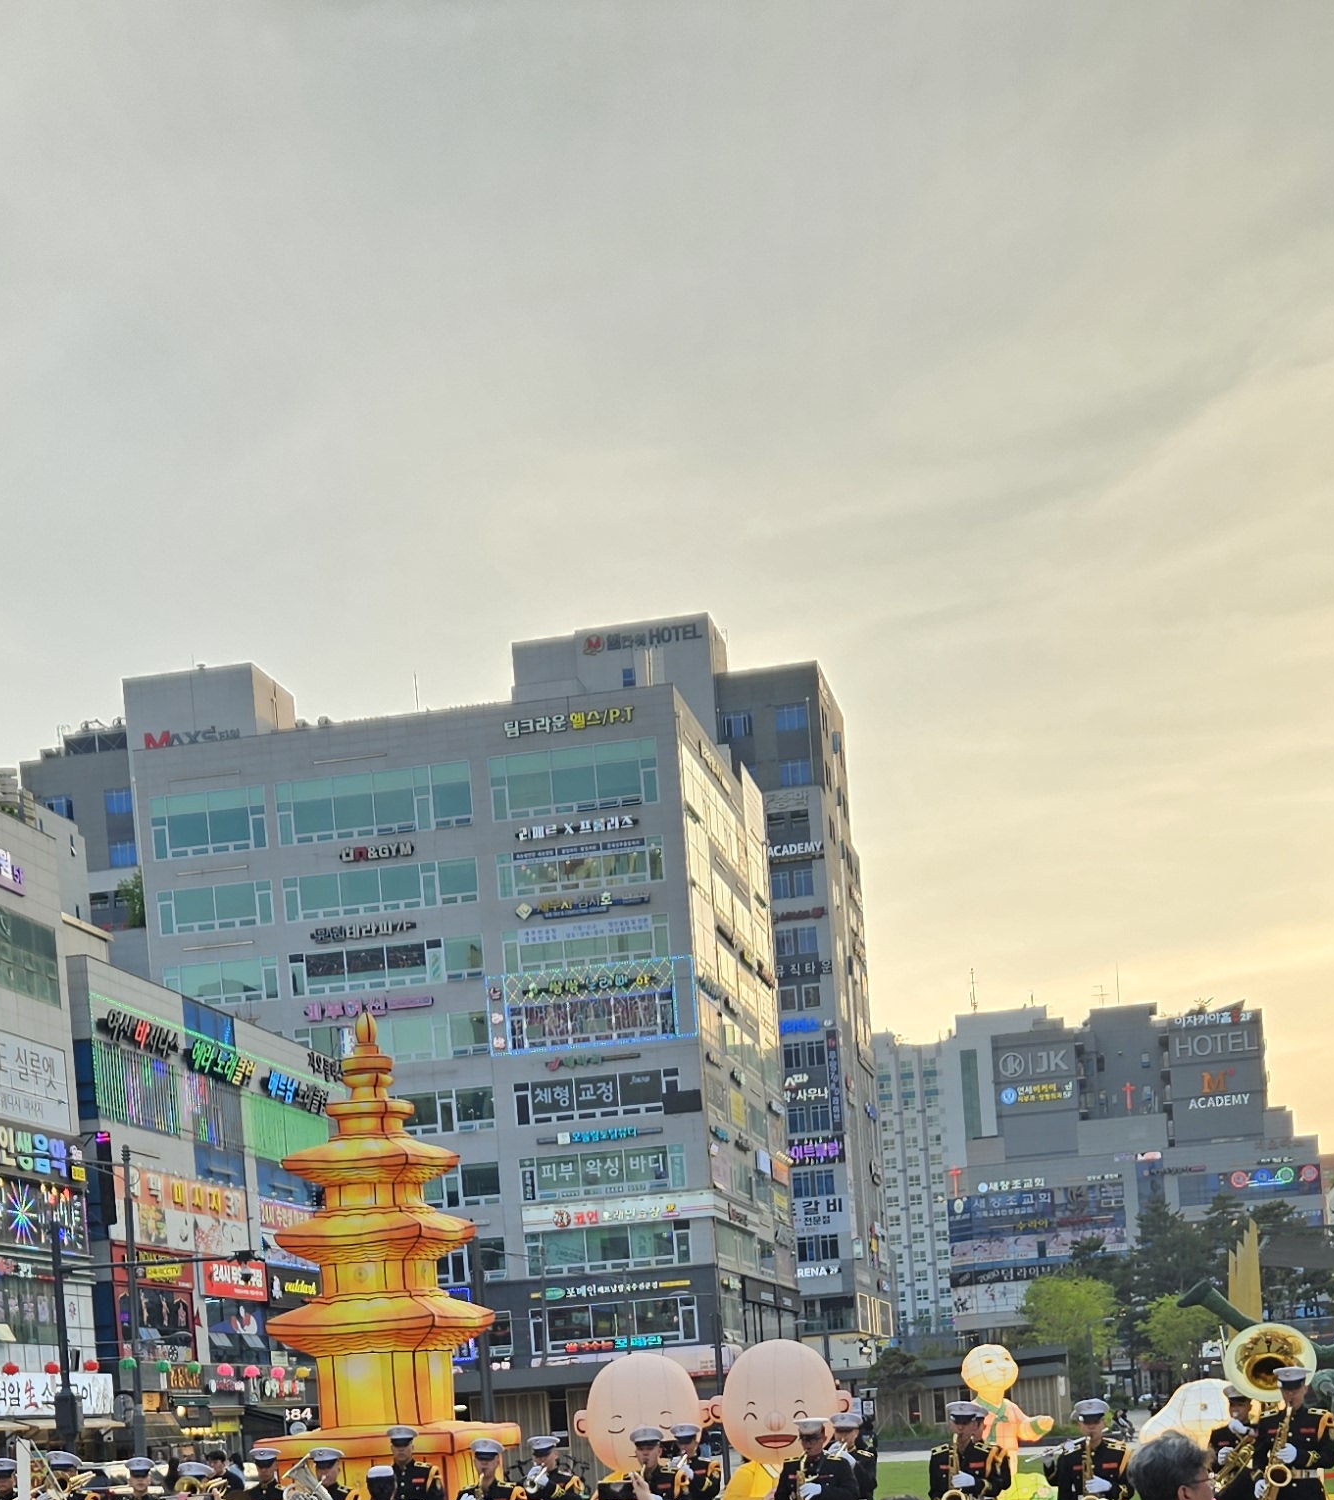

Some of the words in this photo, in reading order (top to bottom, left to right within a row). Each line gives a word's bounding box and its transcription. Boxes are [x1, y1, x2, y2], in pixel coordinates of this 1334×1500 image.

[649, 624, 703, 646] HOTEL
[767, 840, 823, 857] ACADEMY
[1175, 1030, 1259, 1059] HOTEL
[15, 1045, 57, 1091] 실루엣
[1036, 1048, 1069, 1074] JK
[534, 1085, 570, 1107] 체형
[578, 1081, 614, 1103] 교정
[1188, 1093, 1251, 1110] ACADEMY
[785, 1143, 840, 1160] 이트클럽
[540, 1160, 576, 1182] 피부
[585, 1156, 620, 1178] 왁싱
[629, 1153, 664, 1175] 바디
[988, 1176, 1046, 1192] 새창조교회
[793, 1266, 828, 1279] RENA
